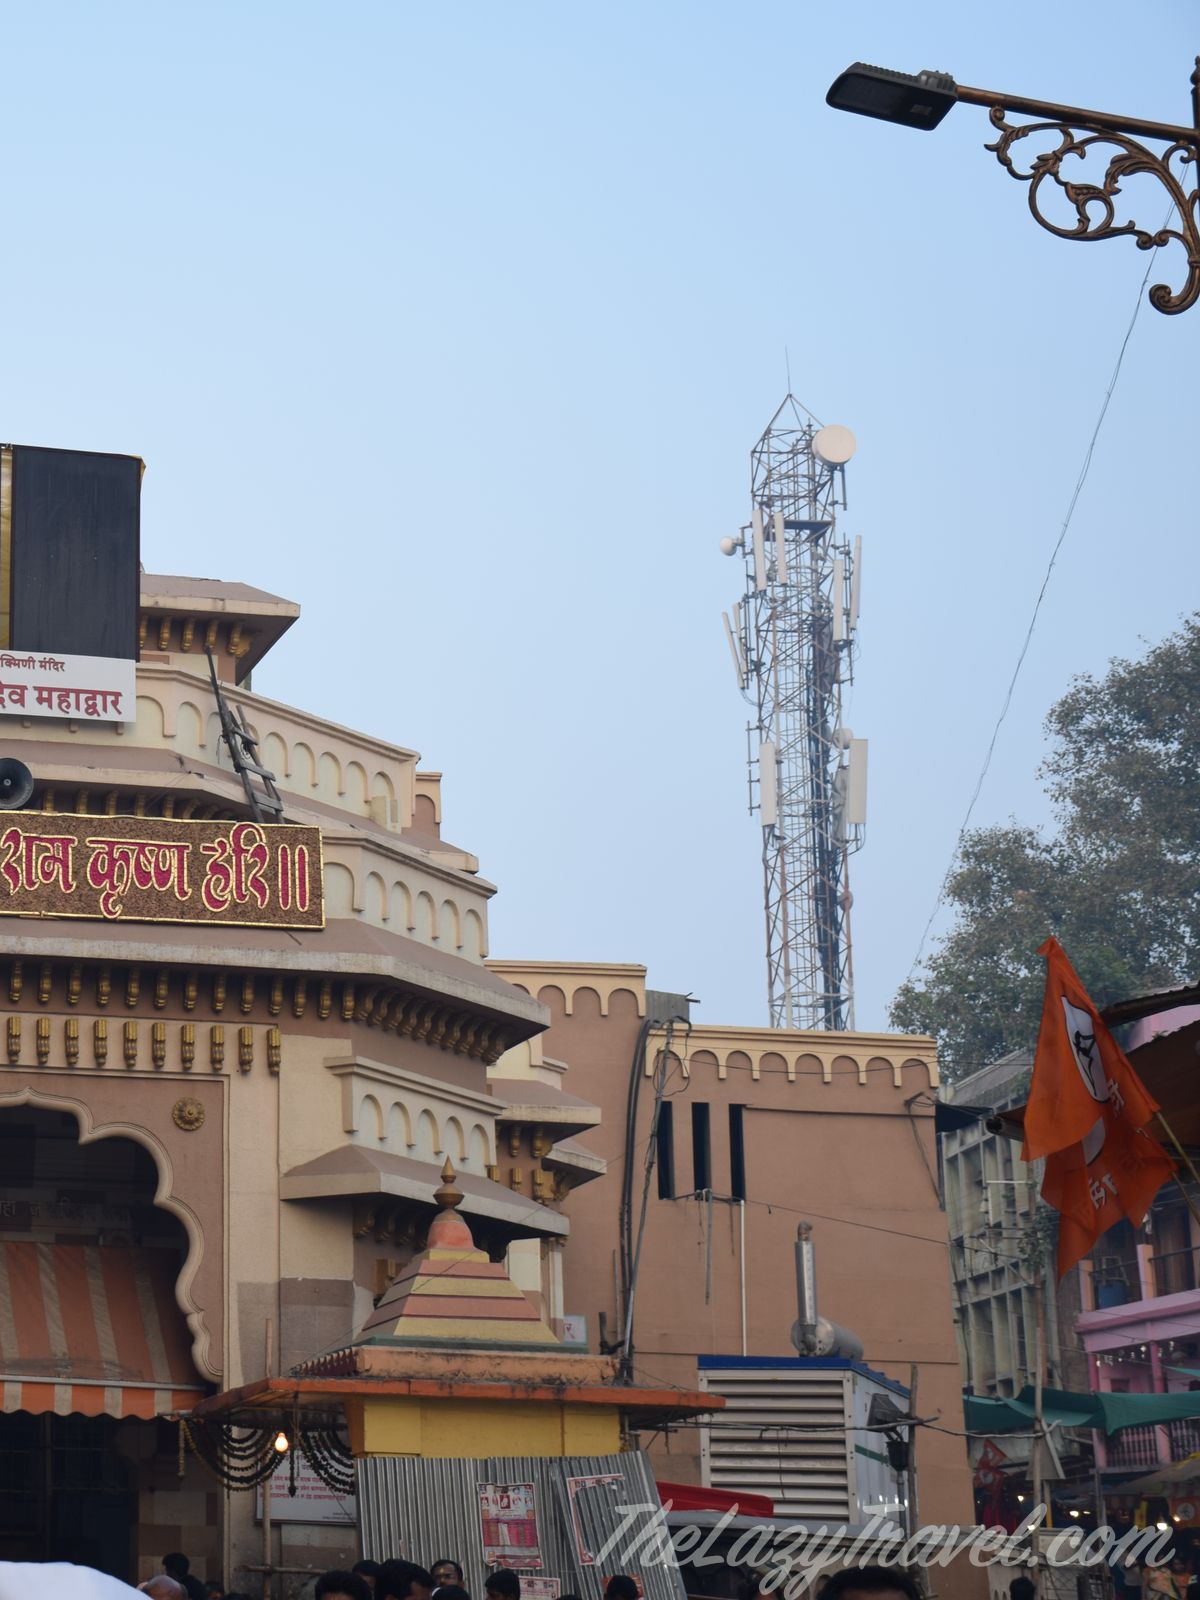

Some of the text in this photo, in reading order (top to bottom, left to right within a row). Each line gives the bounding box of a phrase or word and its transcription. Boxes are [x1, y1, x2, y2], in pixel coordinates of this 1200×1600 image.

[39, 656, 65, 672] मंदिर
[33, 685, 123, 717] महाद्वार
[0, 827, 77, 896] राम
[85, 836, 192, 919] कृष्ण
[200, 821, 270, 912] हरि
